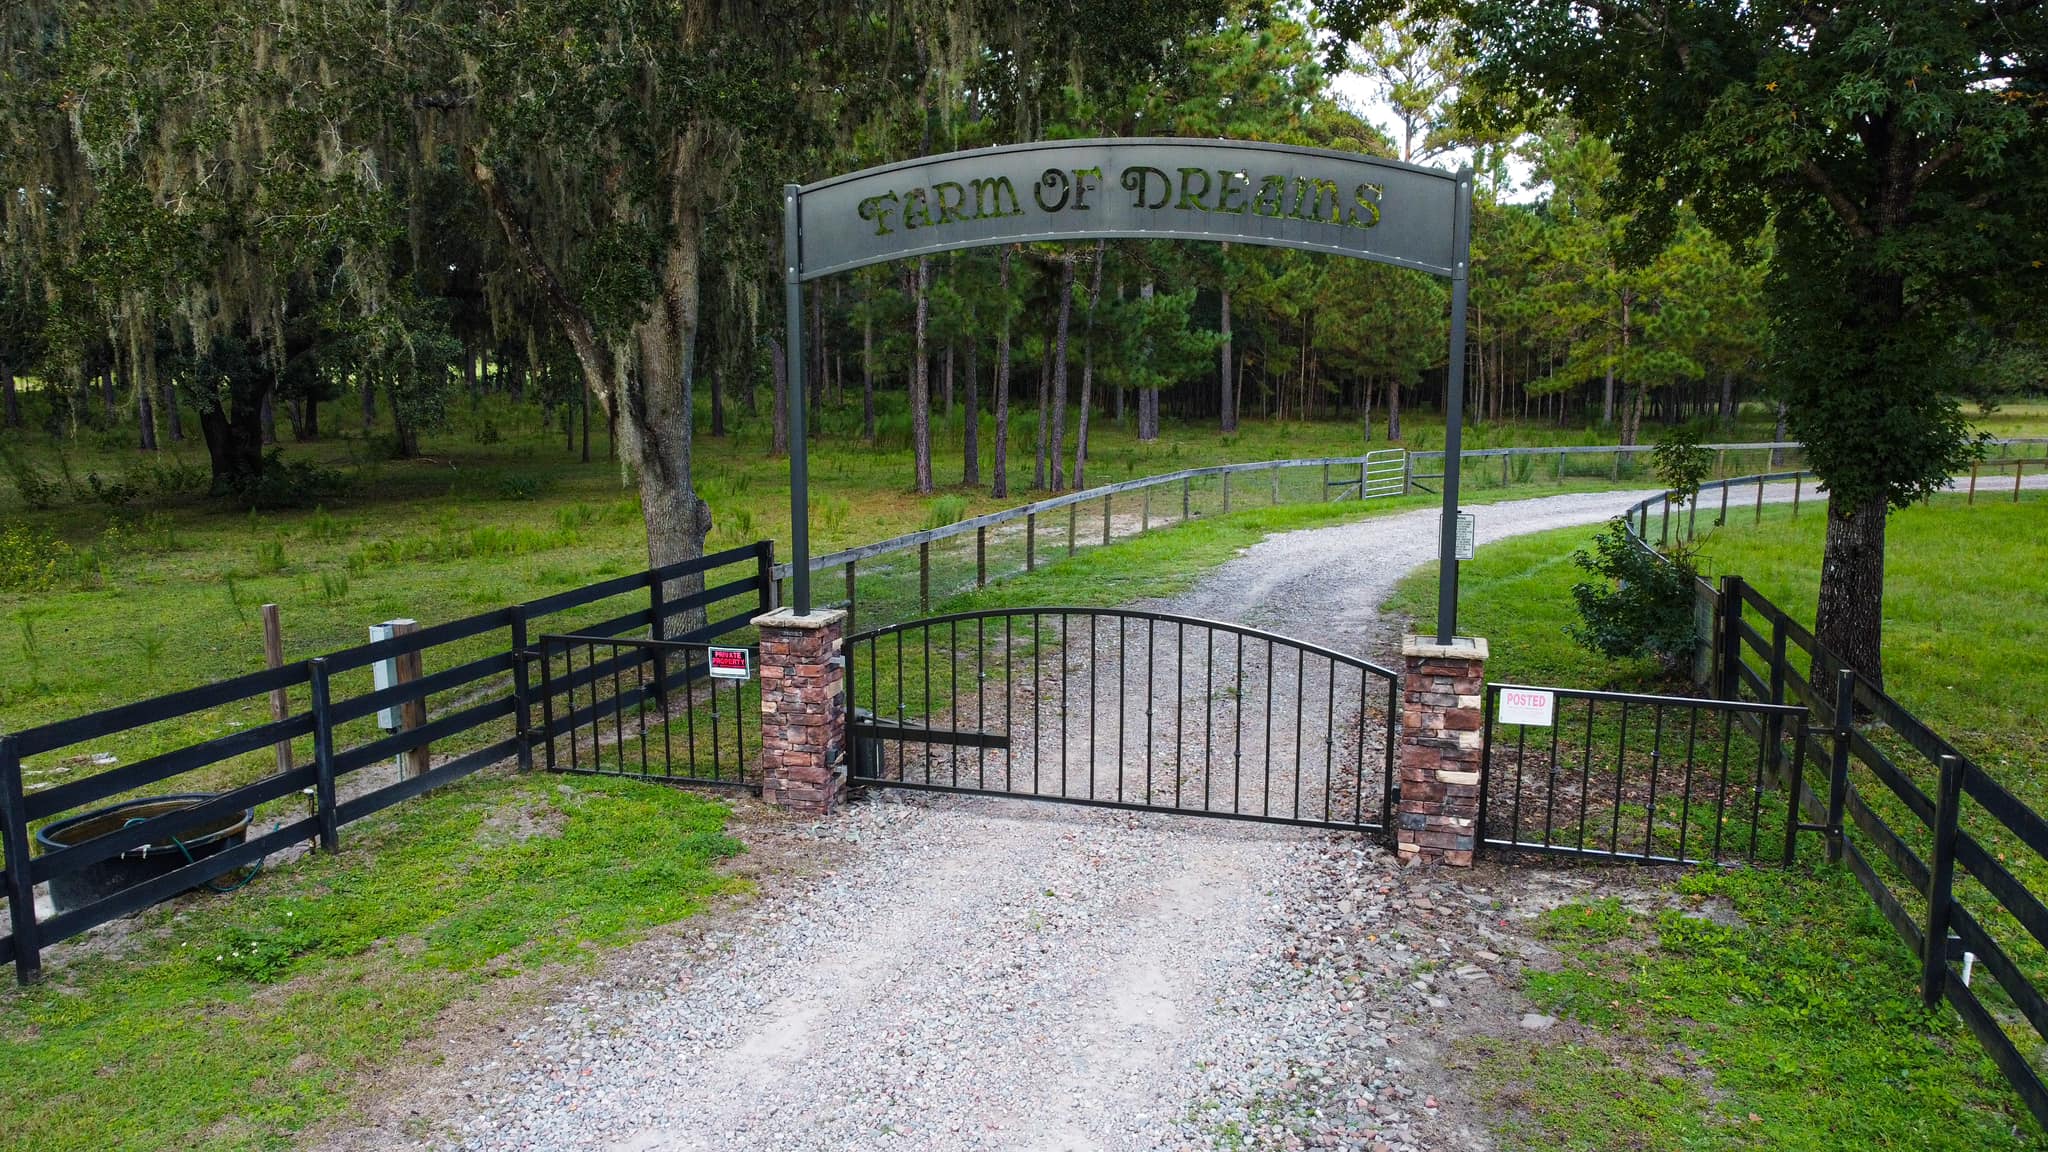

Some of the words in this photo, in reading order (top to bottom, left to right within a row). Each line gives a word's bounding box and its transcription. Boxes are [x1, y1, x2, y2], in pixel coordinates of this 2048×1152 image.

[858, 176, 1025, 236] FARM
[1034, 165, 1103, 213] OF
[1507, 693, 1546, 707] POSTED
